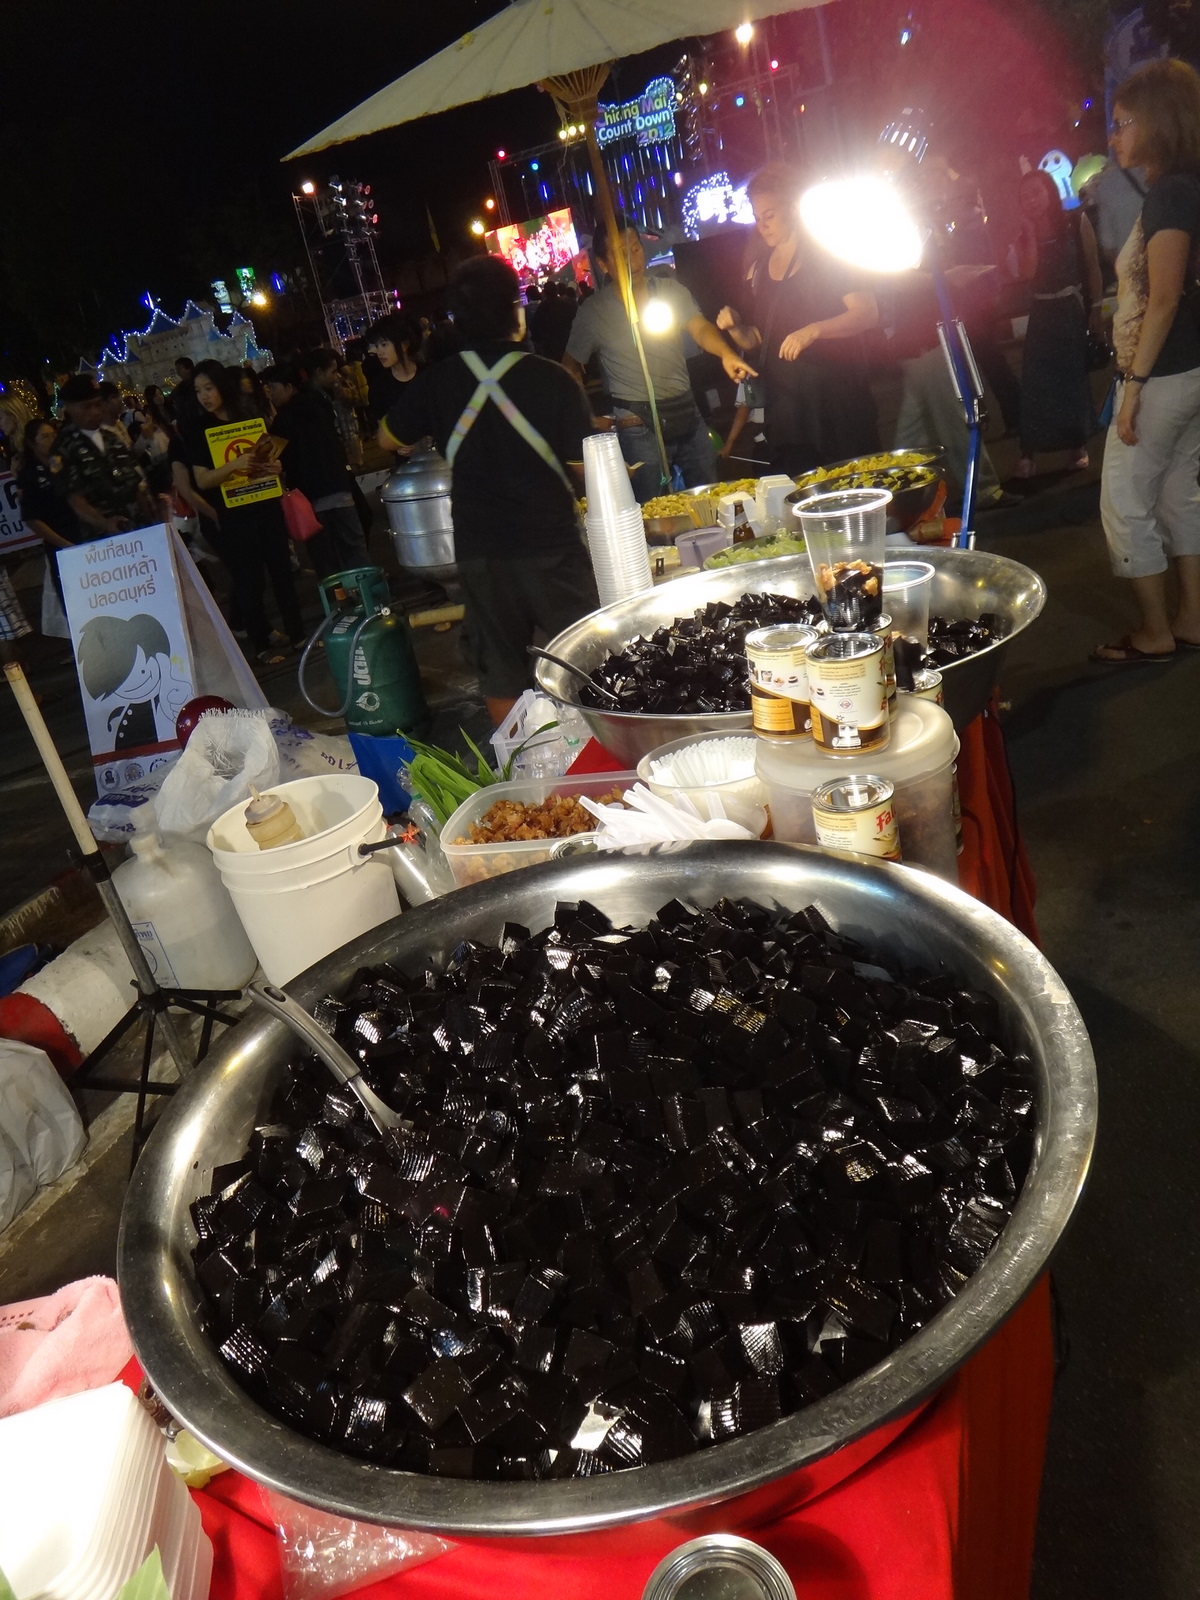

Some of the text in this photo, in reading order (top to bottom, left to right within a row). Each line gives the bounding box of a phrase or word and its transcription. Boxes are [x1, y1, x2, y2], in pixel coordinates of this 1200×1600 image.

[641, 96, 667, 114] Mai
[598, 109, 670, 141] Count Down
[639, 123, 673, 144] 2012
[84, 540, 144, 565] พื้นที่สนุก
[79, 555, 158, 590] ปลอดเหล้า
[88, 575, 157, 609] ปลอดบุหรี่
[876, 803, 897, 832] Fal
